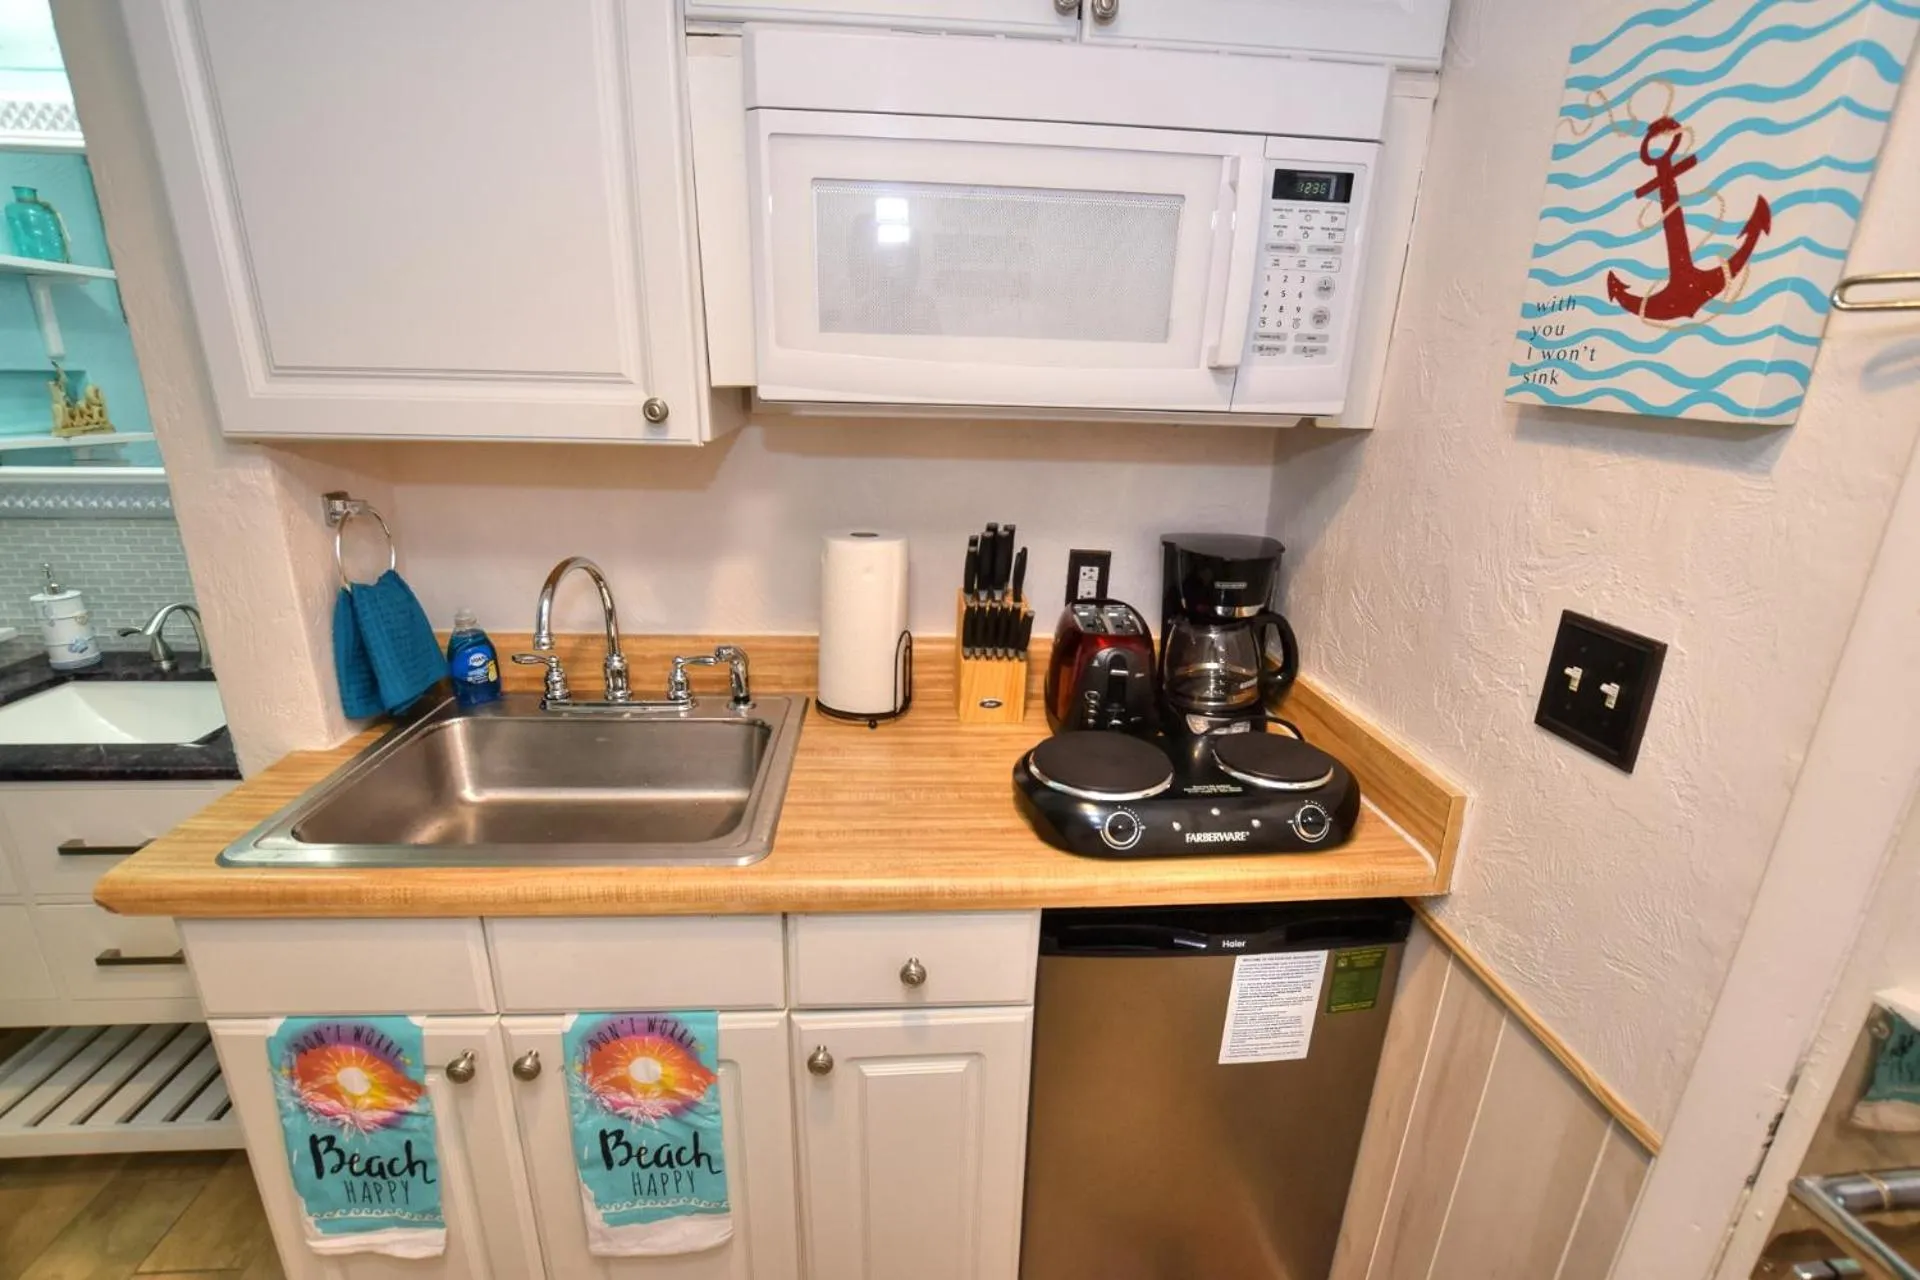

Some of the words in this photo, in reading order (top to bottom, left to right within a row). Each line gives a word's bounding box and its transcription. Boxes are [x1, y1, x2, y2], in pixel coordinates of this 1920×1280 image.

[1536, 294, 1577, 311] with
[1528, 324, 1565, 341] you
[1541, 345, 1596, 362] won't
[1523, 368, 1558, 385] sink
[1185, 831, 1247, 843] FARBERWARE
[1221, 940, 1247, 948] Haier
[292, 1024, 341, 1055] DON'T
[588, 1017, 637, 1051] DON'T
[309, 1134, 436, 1184] Beach
[599, 1128, 722, 1174] Beach
[343, 1180, 410, 1204] HAPPY
[631, 1169, 695, 1196] HAPPY
